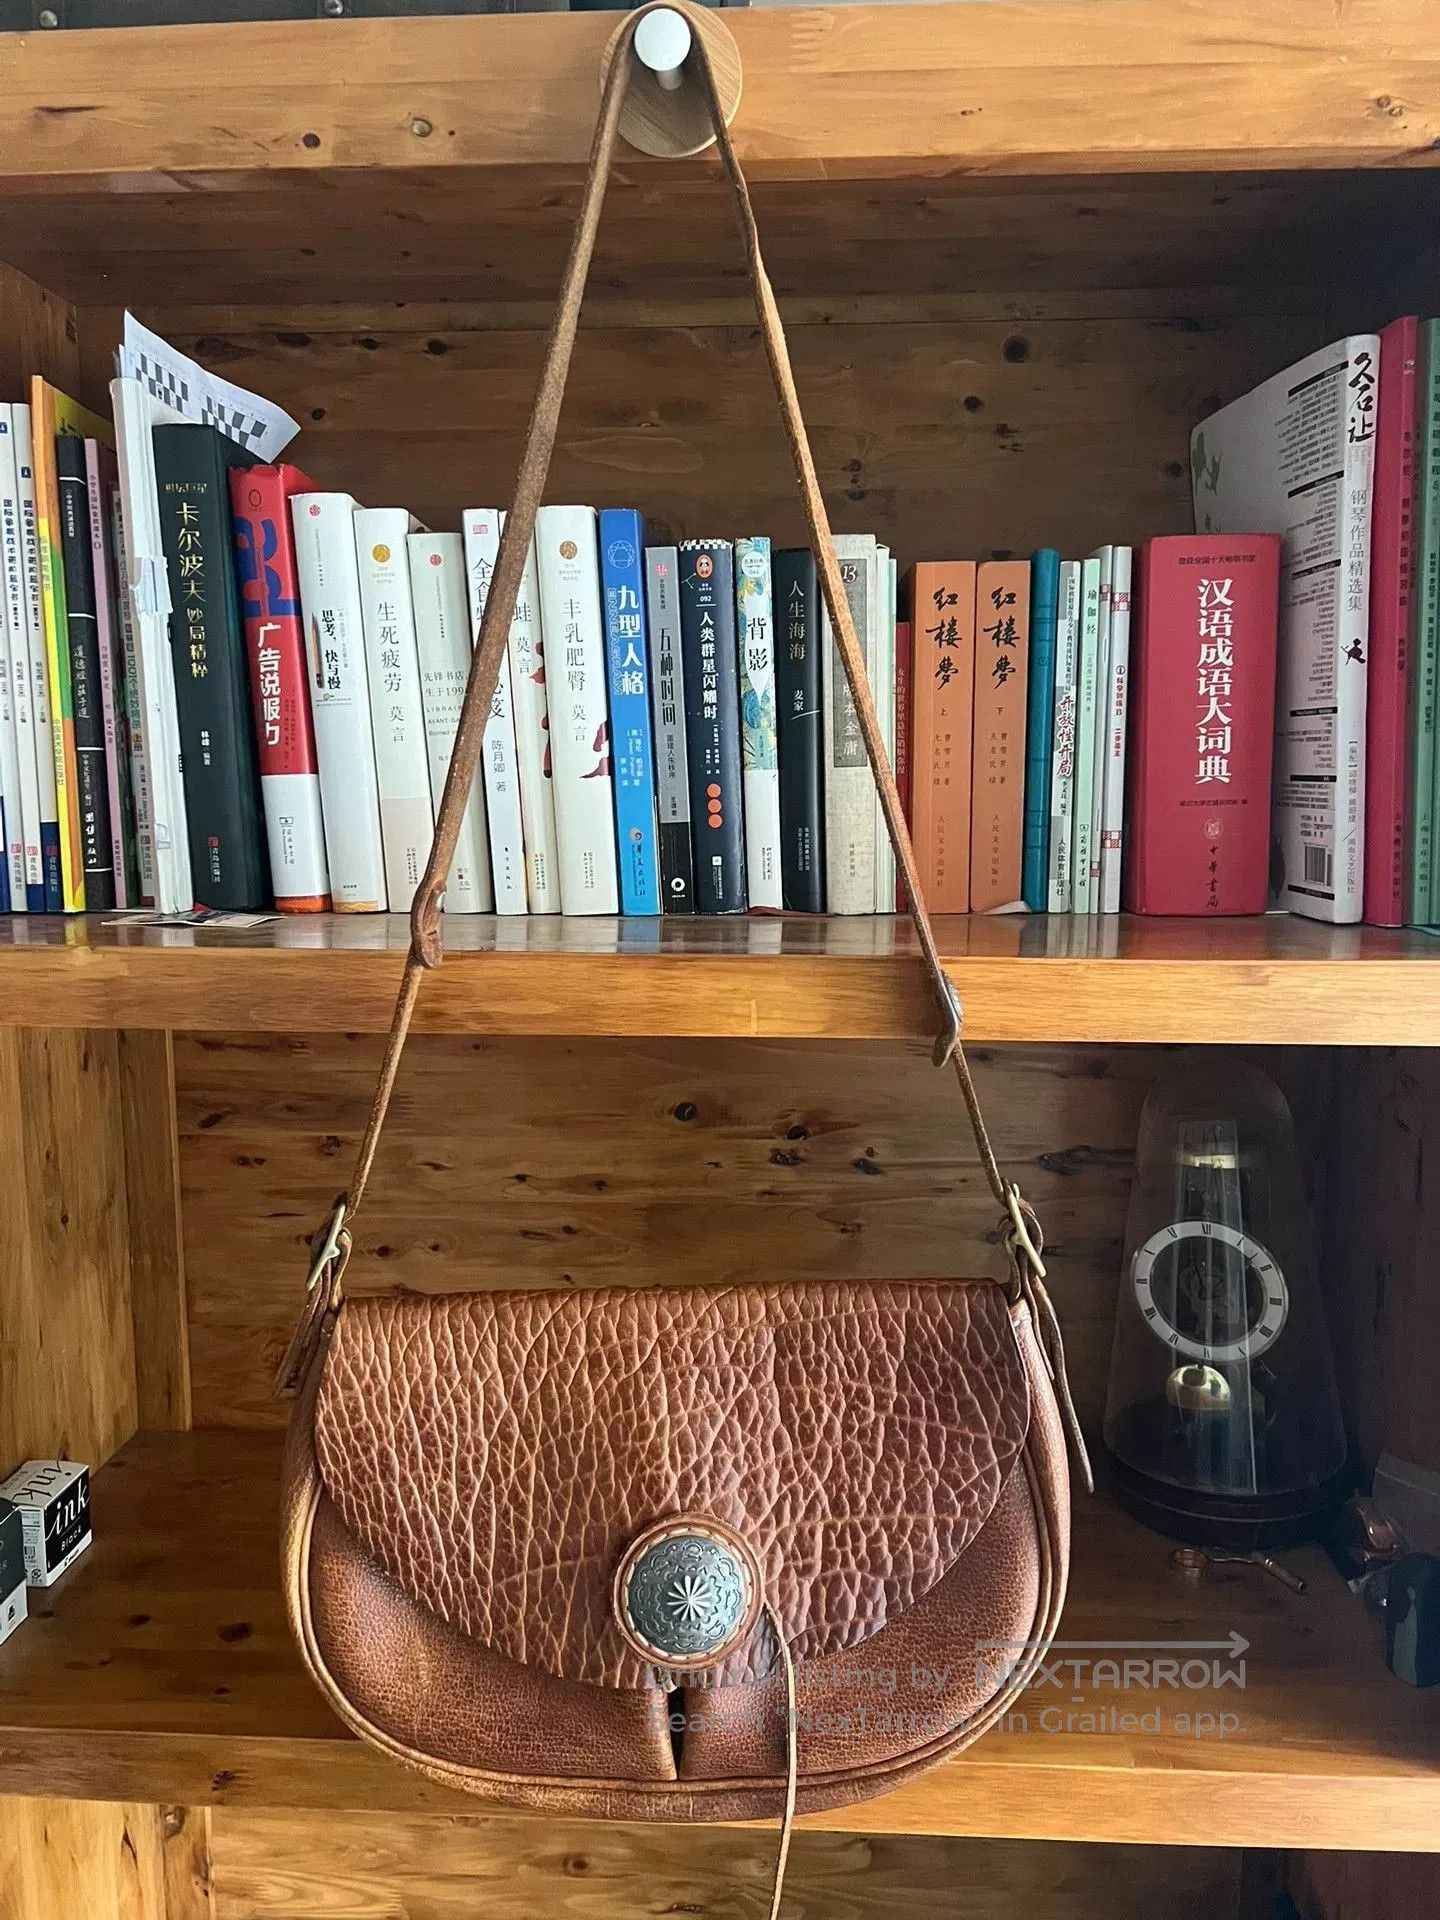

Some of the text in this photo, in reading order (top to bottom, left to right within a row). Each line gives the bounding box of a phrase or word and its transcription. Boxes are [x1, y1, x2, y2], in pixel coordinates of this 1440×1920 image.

[378, 602, 401, 692] 生死疲劳
[513, 602, 532, 623] 蛙
[562, 598, 587, 692] 丰乳肥臀
[617, 585, 644, 696] 九型人格
[747, 617, 768, 671] 背影
[789, 580, 805, 660] 人生海海
[257, 621, 282, 746] 广告说服力
[425, 687, 467, 697] 生于199
[659, 627, 676, 726] 五种时间
[699, 611, 718, 719] 人类群星闪耀时
[1195, 578, 1235, 784] 汉语成语大词典
[940, 707, 947, 716] 上
[997, 707, 1004, 716] 下
[1206, 845, 1220, 908] 中华书局
[45, 1478, 90, 1541] ink
